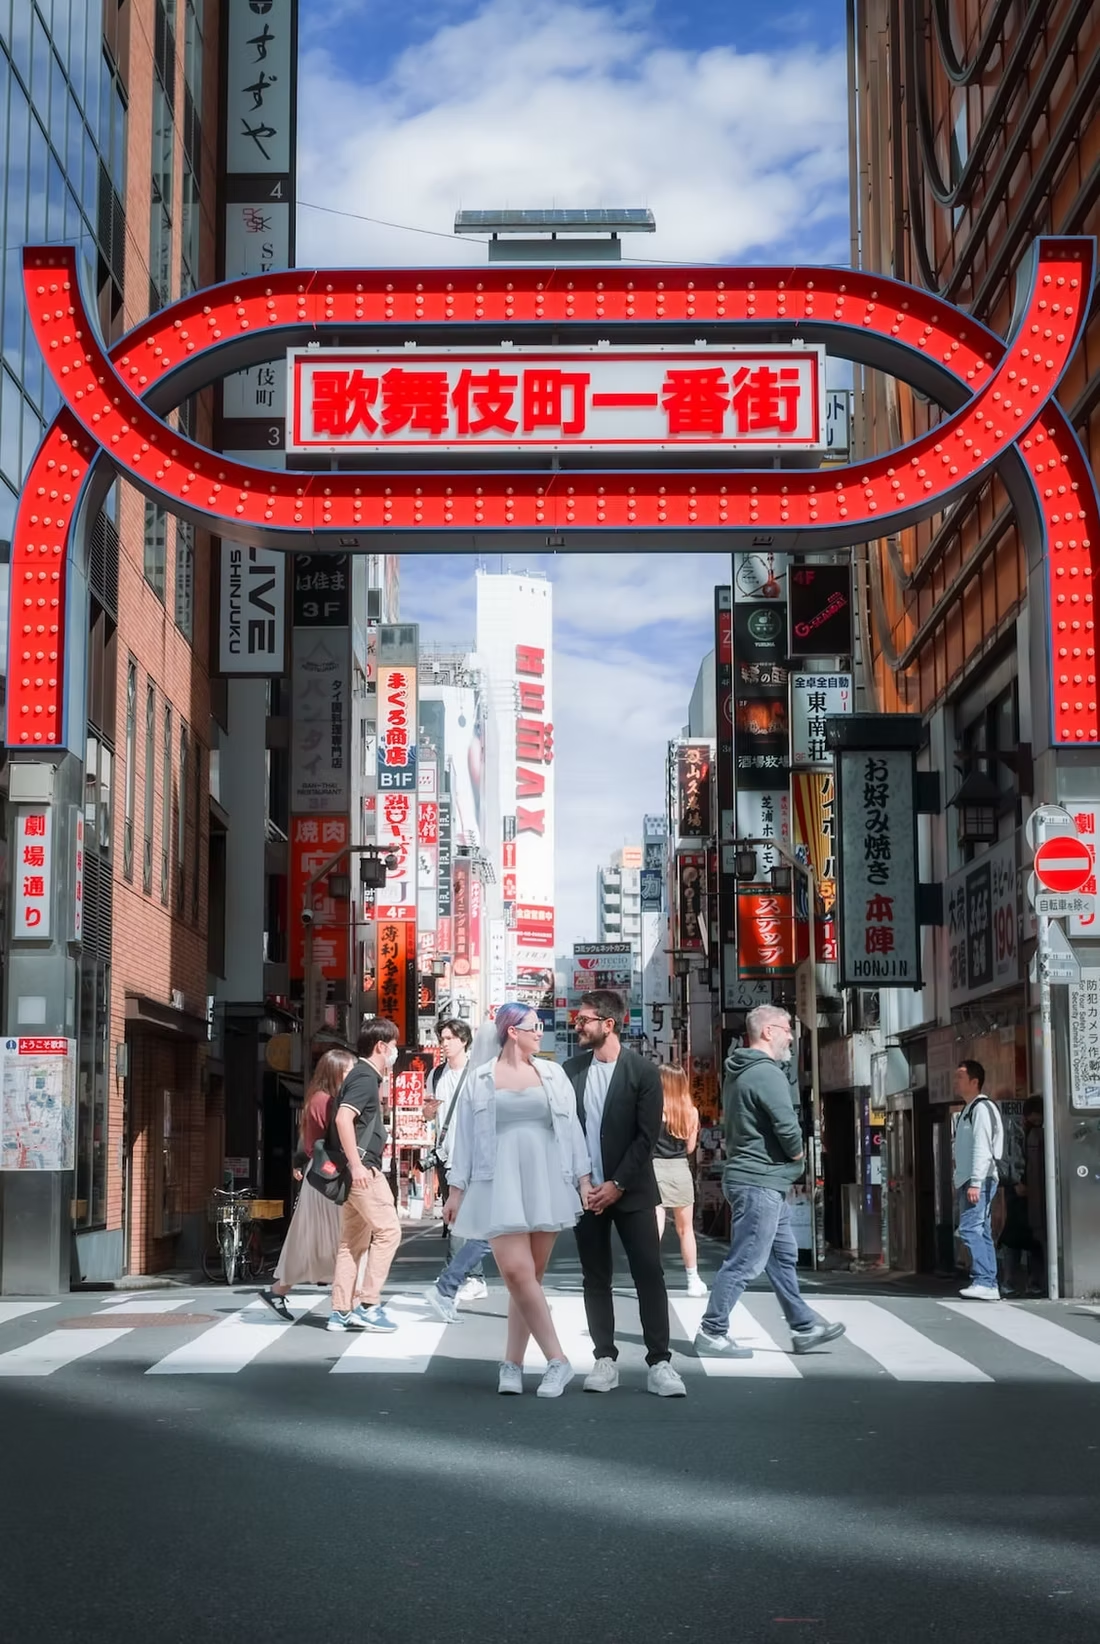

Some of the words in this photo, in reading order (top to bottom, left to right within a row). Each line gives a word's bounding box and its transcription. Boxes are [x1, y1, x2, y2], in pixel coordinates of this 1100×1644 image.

[241, 24, 277, 161] すずや
[270, 181, 283, 199] 4
[311, 366, 801, 436] 歌舞伎町一番街
[268, 427, 280, 446] 3
[229, 549, 241, 654] SHINJUKU
[302, 602, 341, 617] 3F
[794, 677, 850, 689] 全卓全自動
[386, 672, 408, 766] まぐろ商店
[806, 691, 828, 762] 東南荘
[380, 772, 413, 787] B1F
[295, 820, 346, 844] 焼肉
[863, 758, 892, 886] お好み焼き
[23, 814, 46, 927] 劇場通り
[386, 906, 407, 918] 4F
[864, 893, 896, 955] 本陣
[1039, 898, 1090, 912] 自転車を除く
[755, 897, 782, 964] ステップ
[853, 960, 908, 977] HONJIN
